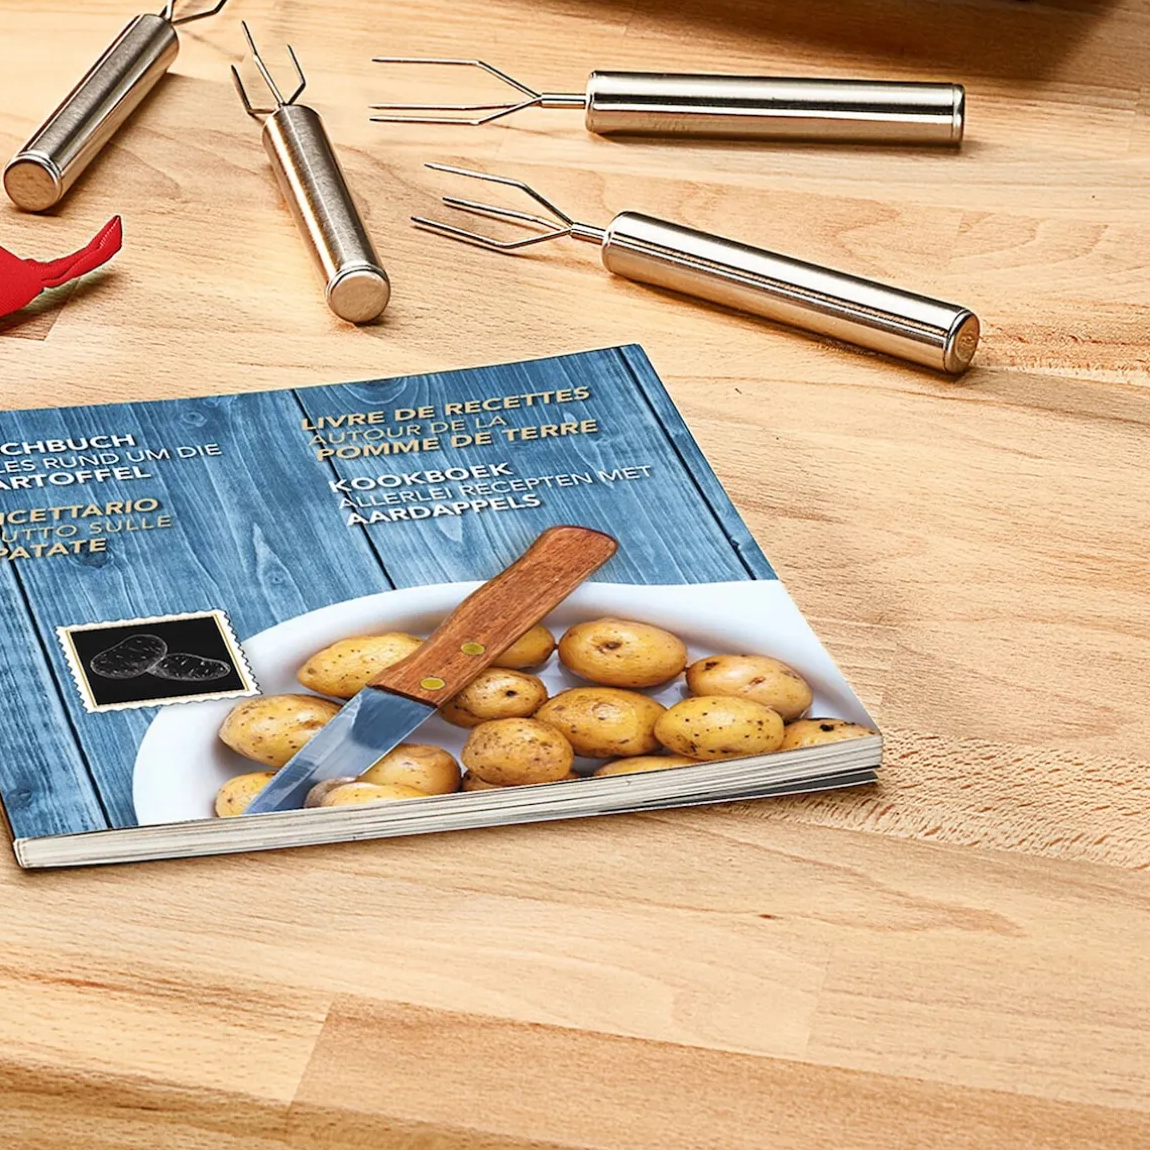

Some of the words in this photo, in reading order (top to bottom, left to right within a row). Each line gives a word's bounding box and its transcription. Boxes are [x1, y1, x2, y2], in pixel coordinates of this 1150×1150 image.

[302, 408, 386, 431] LIVRE
[395, 405, 434, 422] DE
[445, 386, 590, 415] RECETTES
[308, 425, 422, 446] AUTOUR
[431, 420, 466, 433] DE
[475, 415, 506, 429] LA
[317, 437, 439, 462] POMME
[452, 432, 492, 449] DE
[505, 419, 598, 442] TERRE
[43, 454, 119, 470] RUND
[126, 448, 170, 462] UM
[178, 444, 222, 459] DIE
[329, 462, 514, 493] KOOKBOEK
[339, 487, 452, 509] ALLERLEI
[461, 471, 592, 496] RECEPTEN
[598, 465, 651, 483] MET
[89, 514, 172, 535] SULLE
[347, 494, 541, 526] AARDAPPELS
